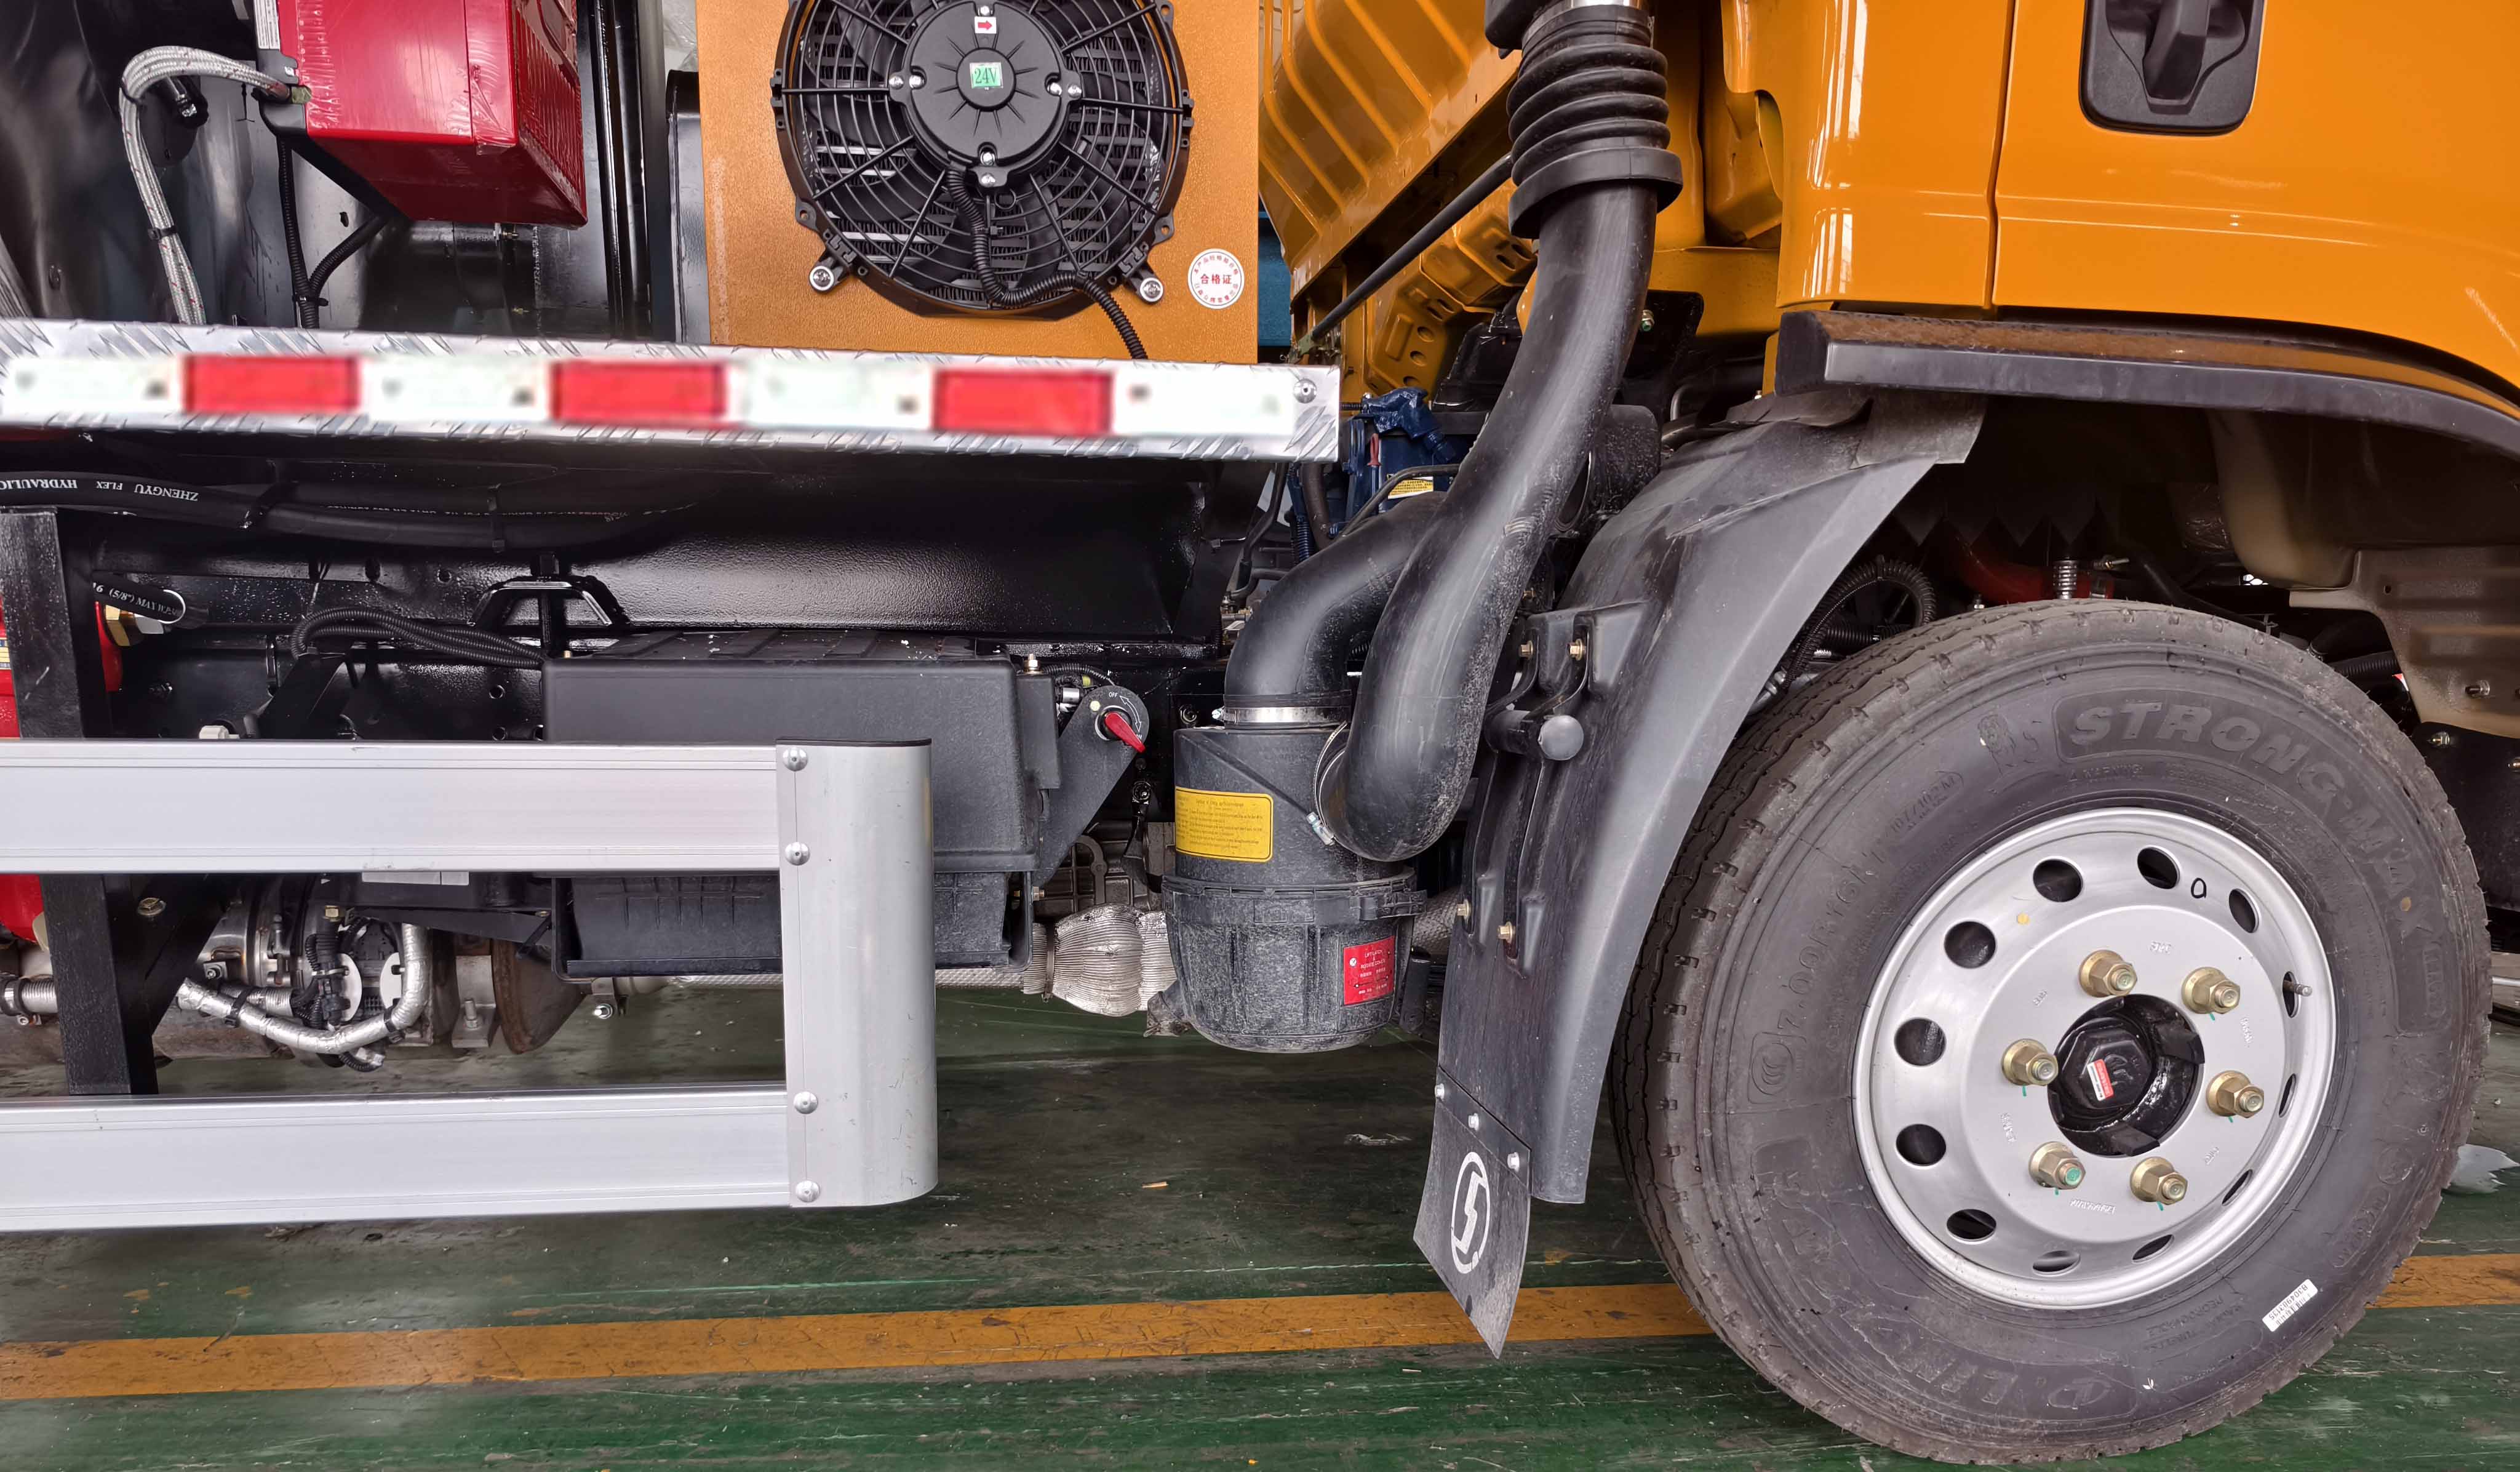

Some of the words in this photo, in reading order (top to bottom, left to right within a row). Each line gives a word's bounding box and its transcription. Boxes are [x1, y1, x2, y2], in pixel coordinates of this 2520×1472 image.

[975, 68, 996, 84] 24V
[1200, 274, 1231, 284] 合格证
[96, 481, 123, 490] FLEX
[134, 484, 199, 502] ZHENGYU
